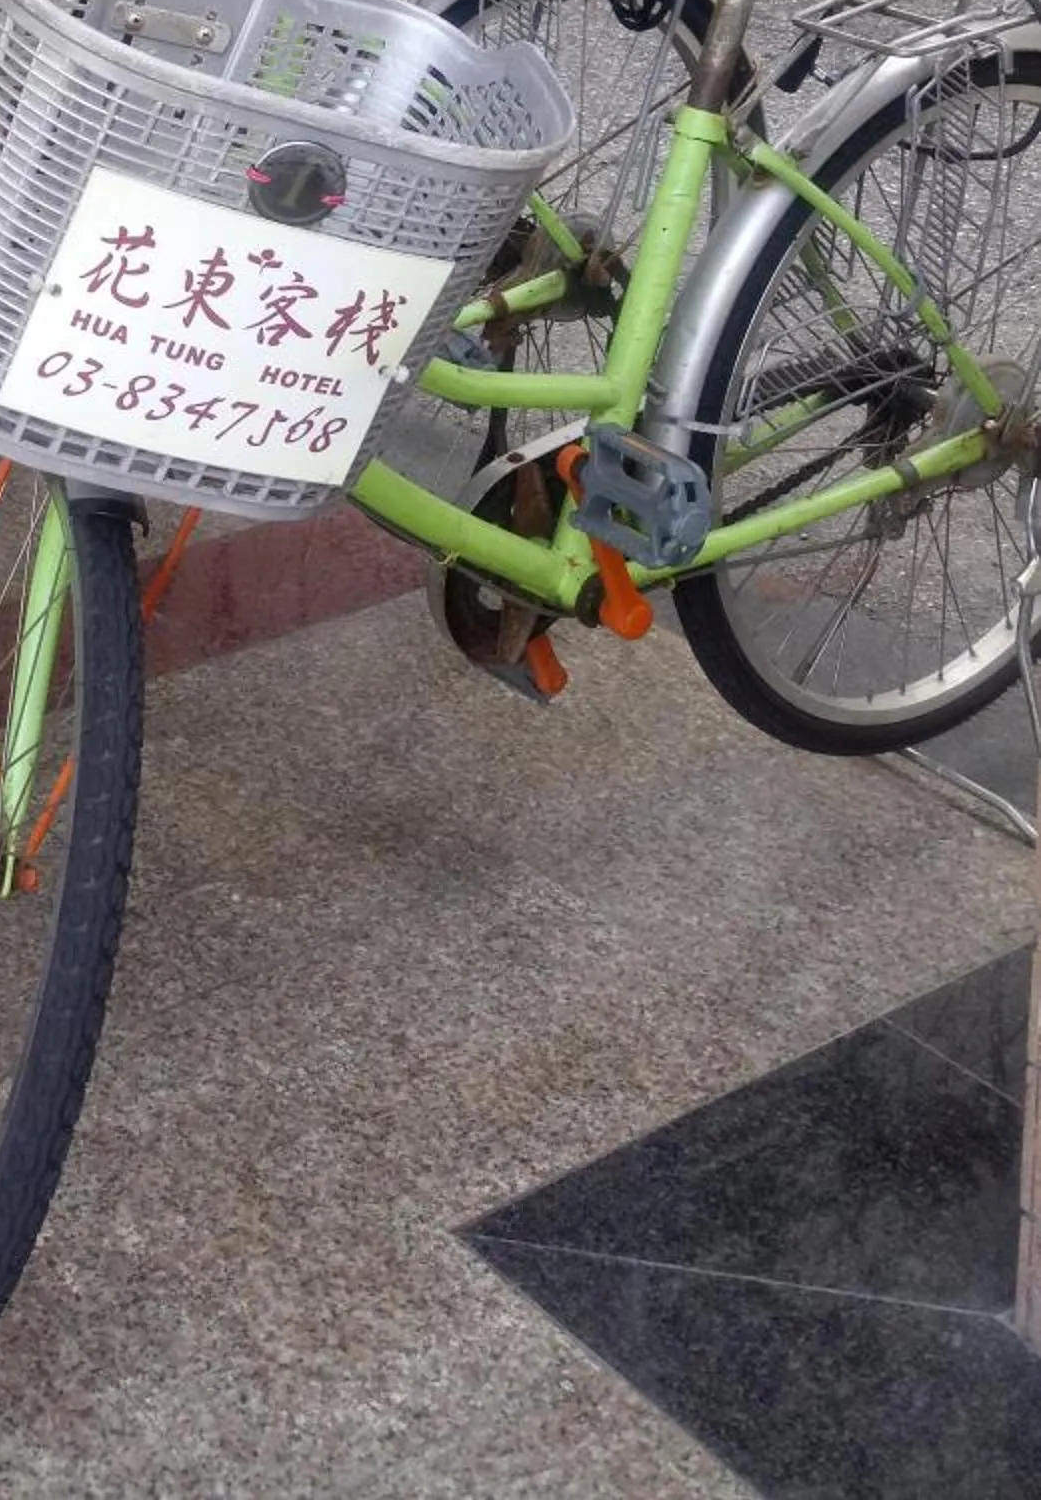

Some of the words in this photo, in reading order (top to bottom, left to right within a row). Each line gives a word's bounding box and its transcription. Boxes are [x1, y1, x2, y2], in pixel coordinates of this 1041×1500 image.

[79, 225, 407, 367] 花東客棧
[36, 350, 349, 453] 03-8347568
[70, 309, 128, 345] HUA
[150, 335, 226, 371] TUNG
[259, 366, 345, 397] HOTEL
